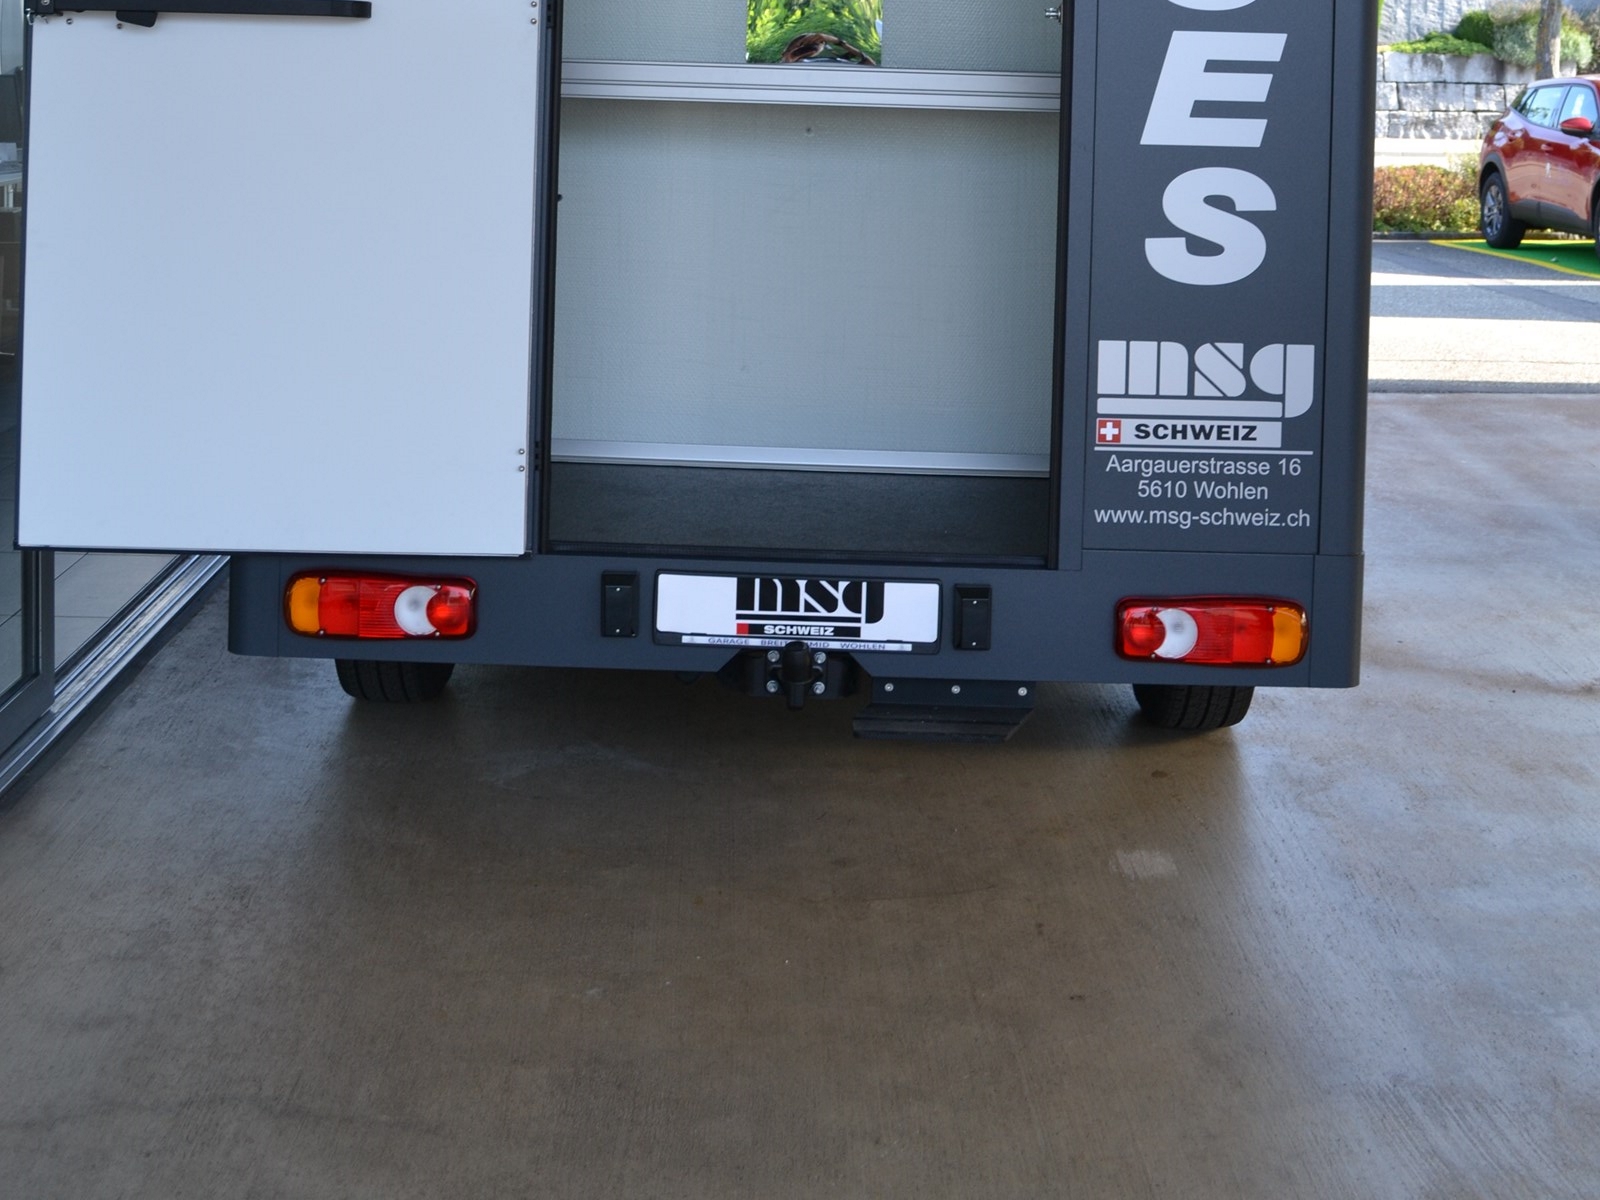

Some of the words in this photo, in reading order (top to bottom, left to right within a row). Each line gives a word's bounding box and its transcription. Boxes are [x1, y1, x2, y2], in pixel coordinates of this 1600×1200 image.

[1133, 423, 1258, 442] SCHWEIZ
[1105, 454, 1271, 477] Aargauerstrasse
[1277, 457, 1302, 477] 16
[1137, 480, 1188, 499] 5610
[1192, 481, 1269, 500] Wohlen
[1094, 507, 1311, 529] www.msg-schweiz.ch
[763, 624, 835, 637] SCHWEIZ
[707, 636, 750, 646] GARAGE
[839, 641, 887, 651] WOHLEN
